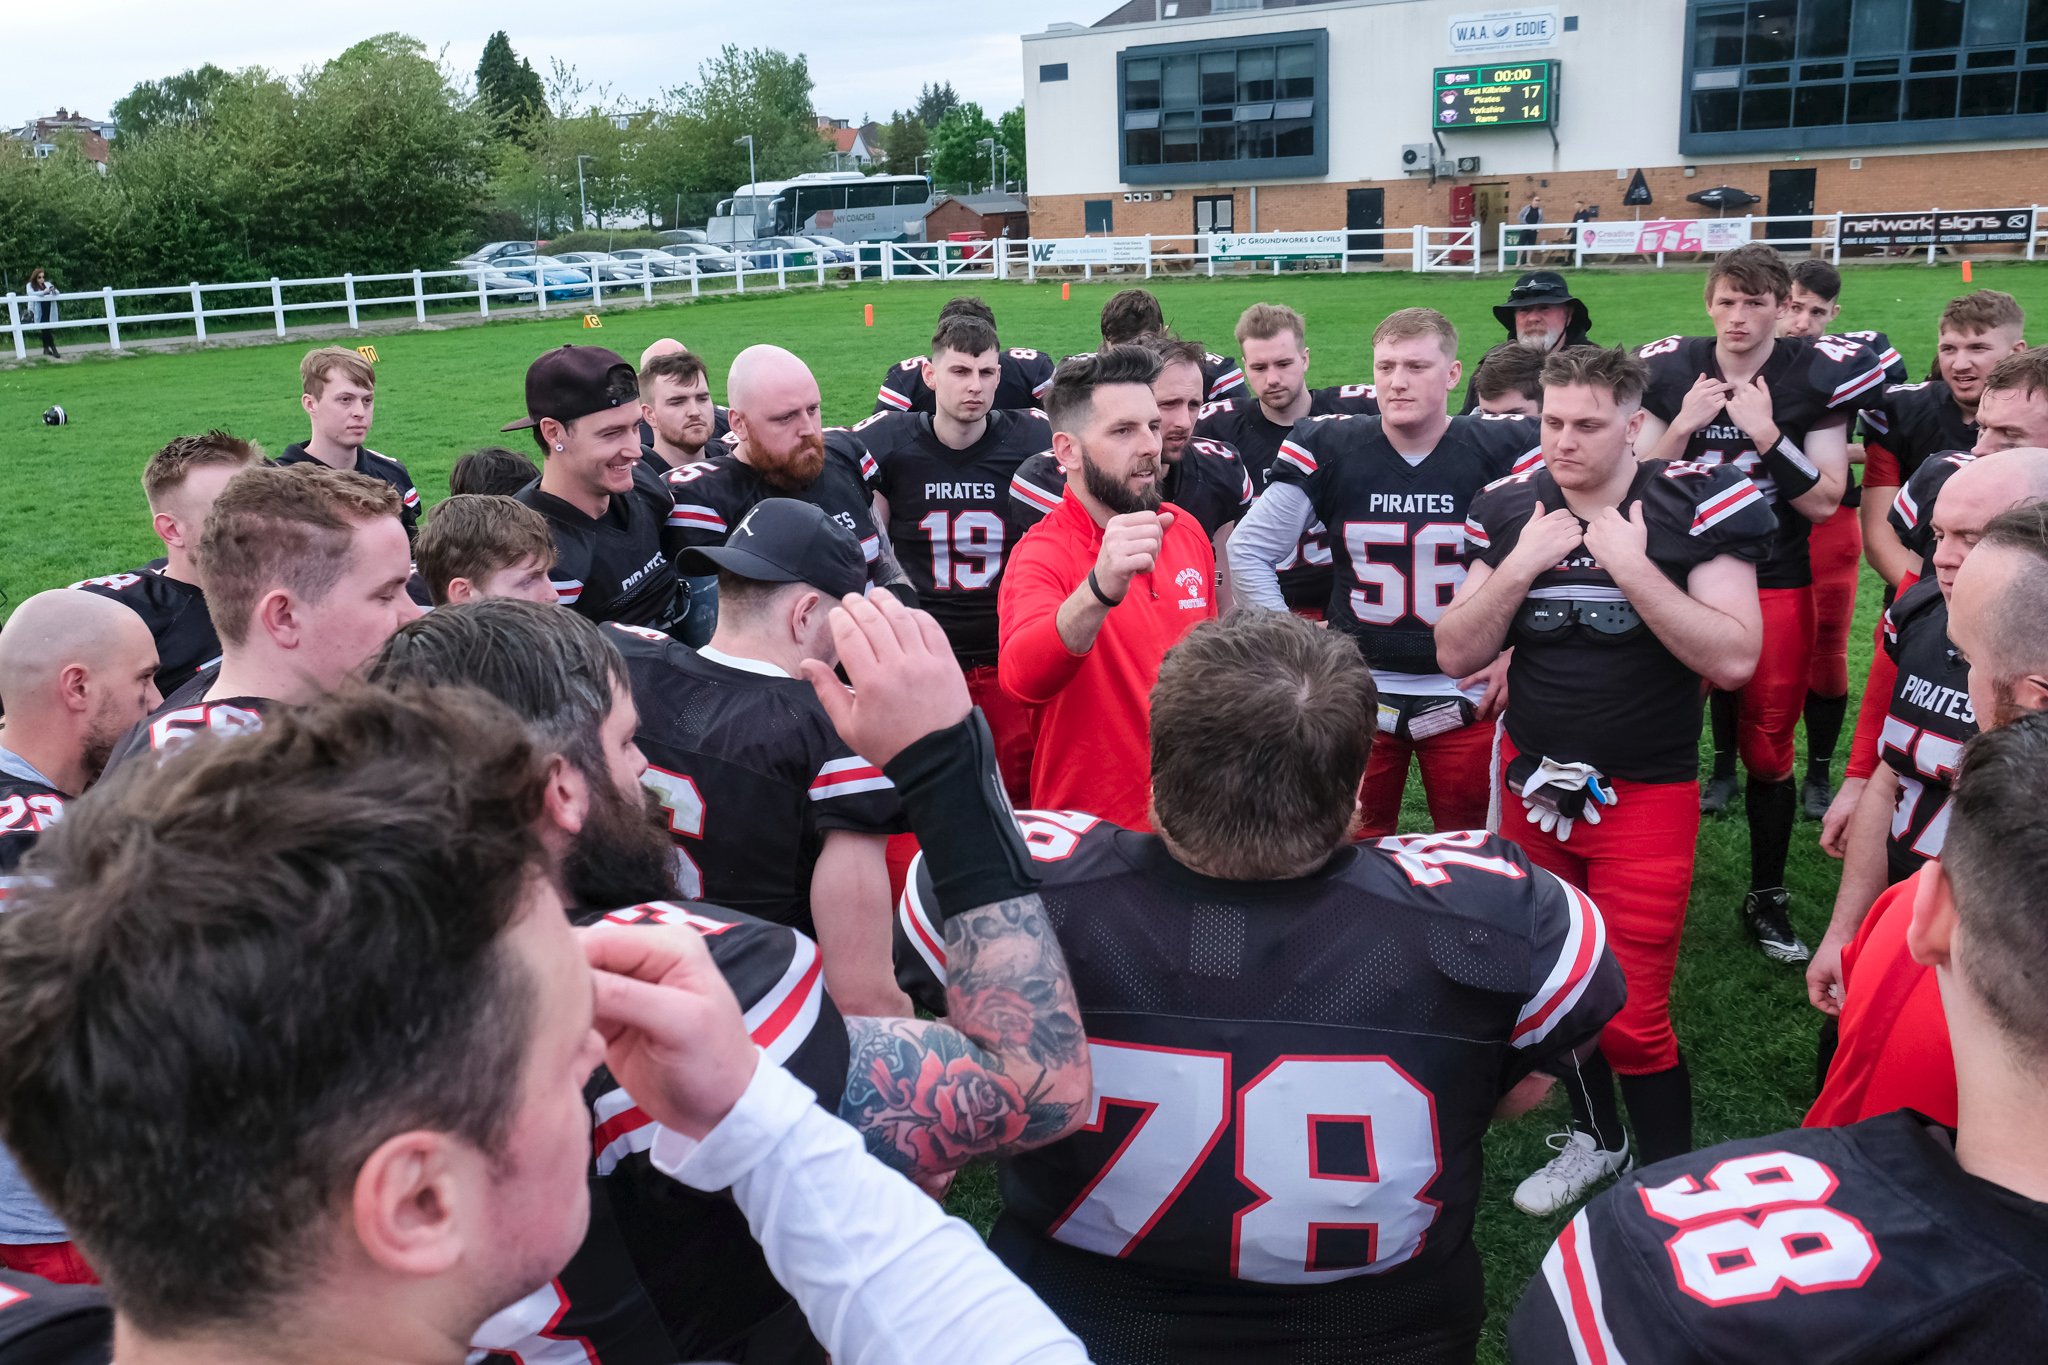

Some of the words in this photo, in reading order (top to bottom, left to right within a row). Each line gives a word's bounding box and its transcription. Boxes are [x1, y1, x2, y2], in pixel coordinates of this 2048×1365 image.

[1457, 26, 1489, 41] W.A.A.
[1515, 20, 1546, 36] EDDIE
[1494, 69, 1531, 82] 00:00
[1522, 85, 1541, 98] 17
[1474, 96, 1501, 104] Pirates
[1469, 106, 1505, 114] Yorkshire
[1521, 105, 1540, 118] 14
[847, 213, 875, 222] COACHES
[1844, 216, 1934, 232] network
[1939, 215, 2000, 232] signs
[1238, 237, 1246, 246] JC
[1249, 237, 1308, 245] GROUNDWORKS
[589, 317, 600, 327] G
[361, 347, 379, 362] 10
[925, 482, 996, 500] PIRATES
[1369, 493, 1455, 514] PIRATES
[919, 510, 1005, 590] 19
[1342, 521, 1467, 627] 56
[1900, 674, 1977, 724] PIRATES
[1048, 1037, 1444, 1285] 78
[1638, 1150, 1882, 1308] 98
